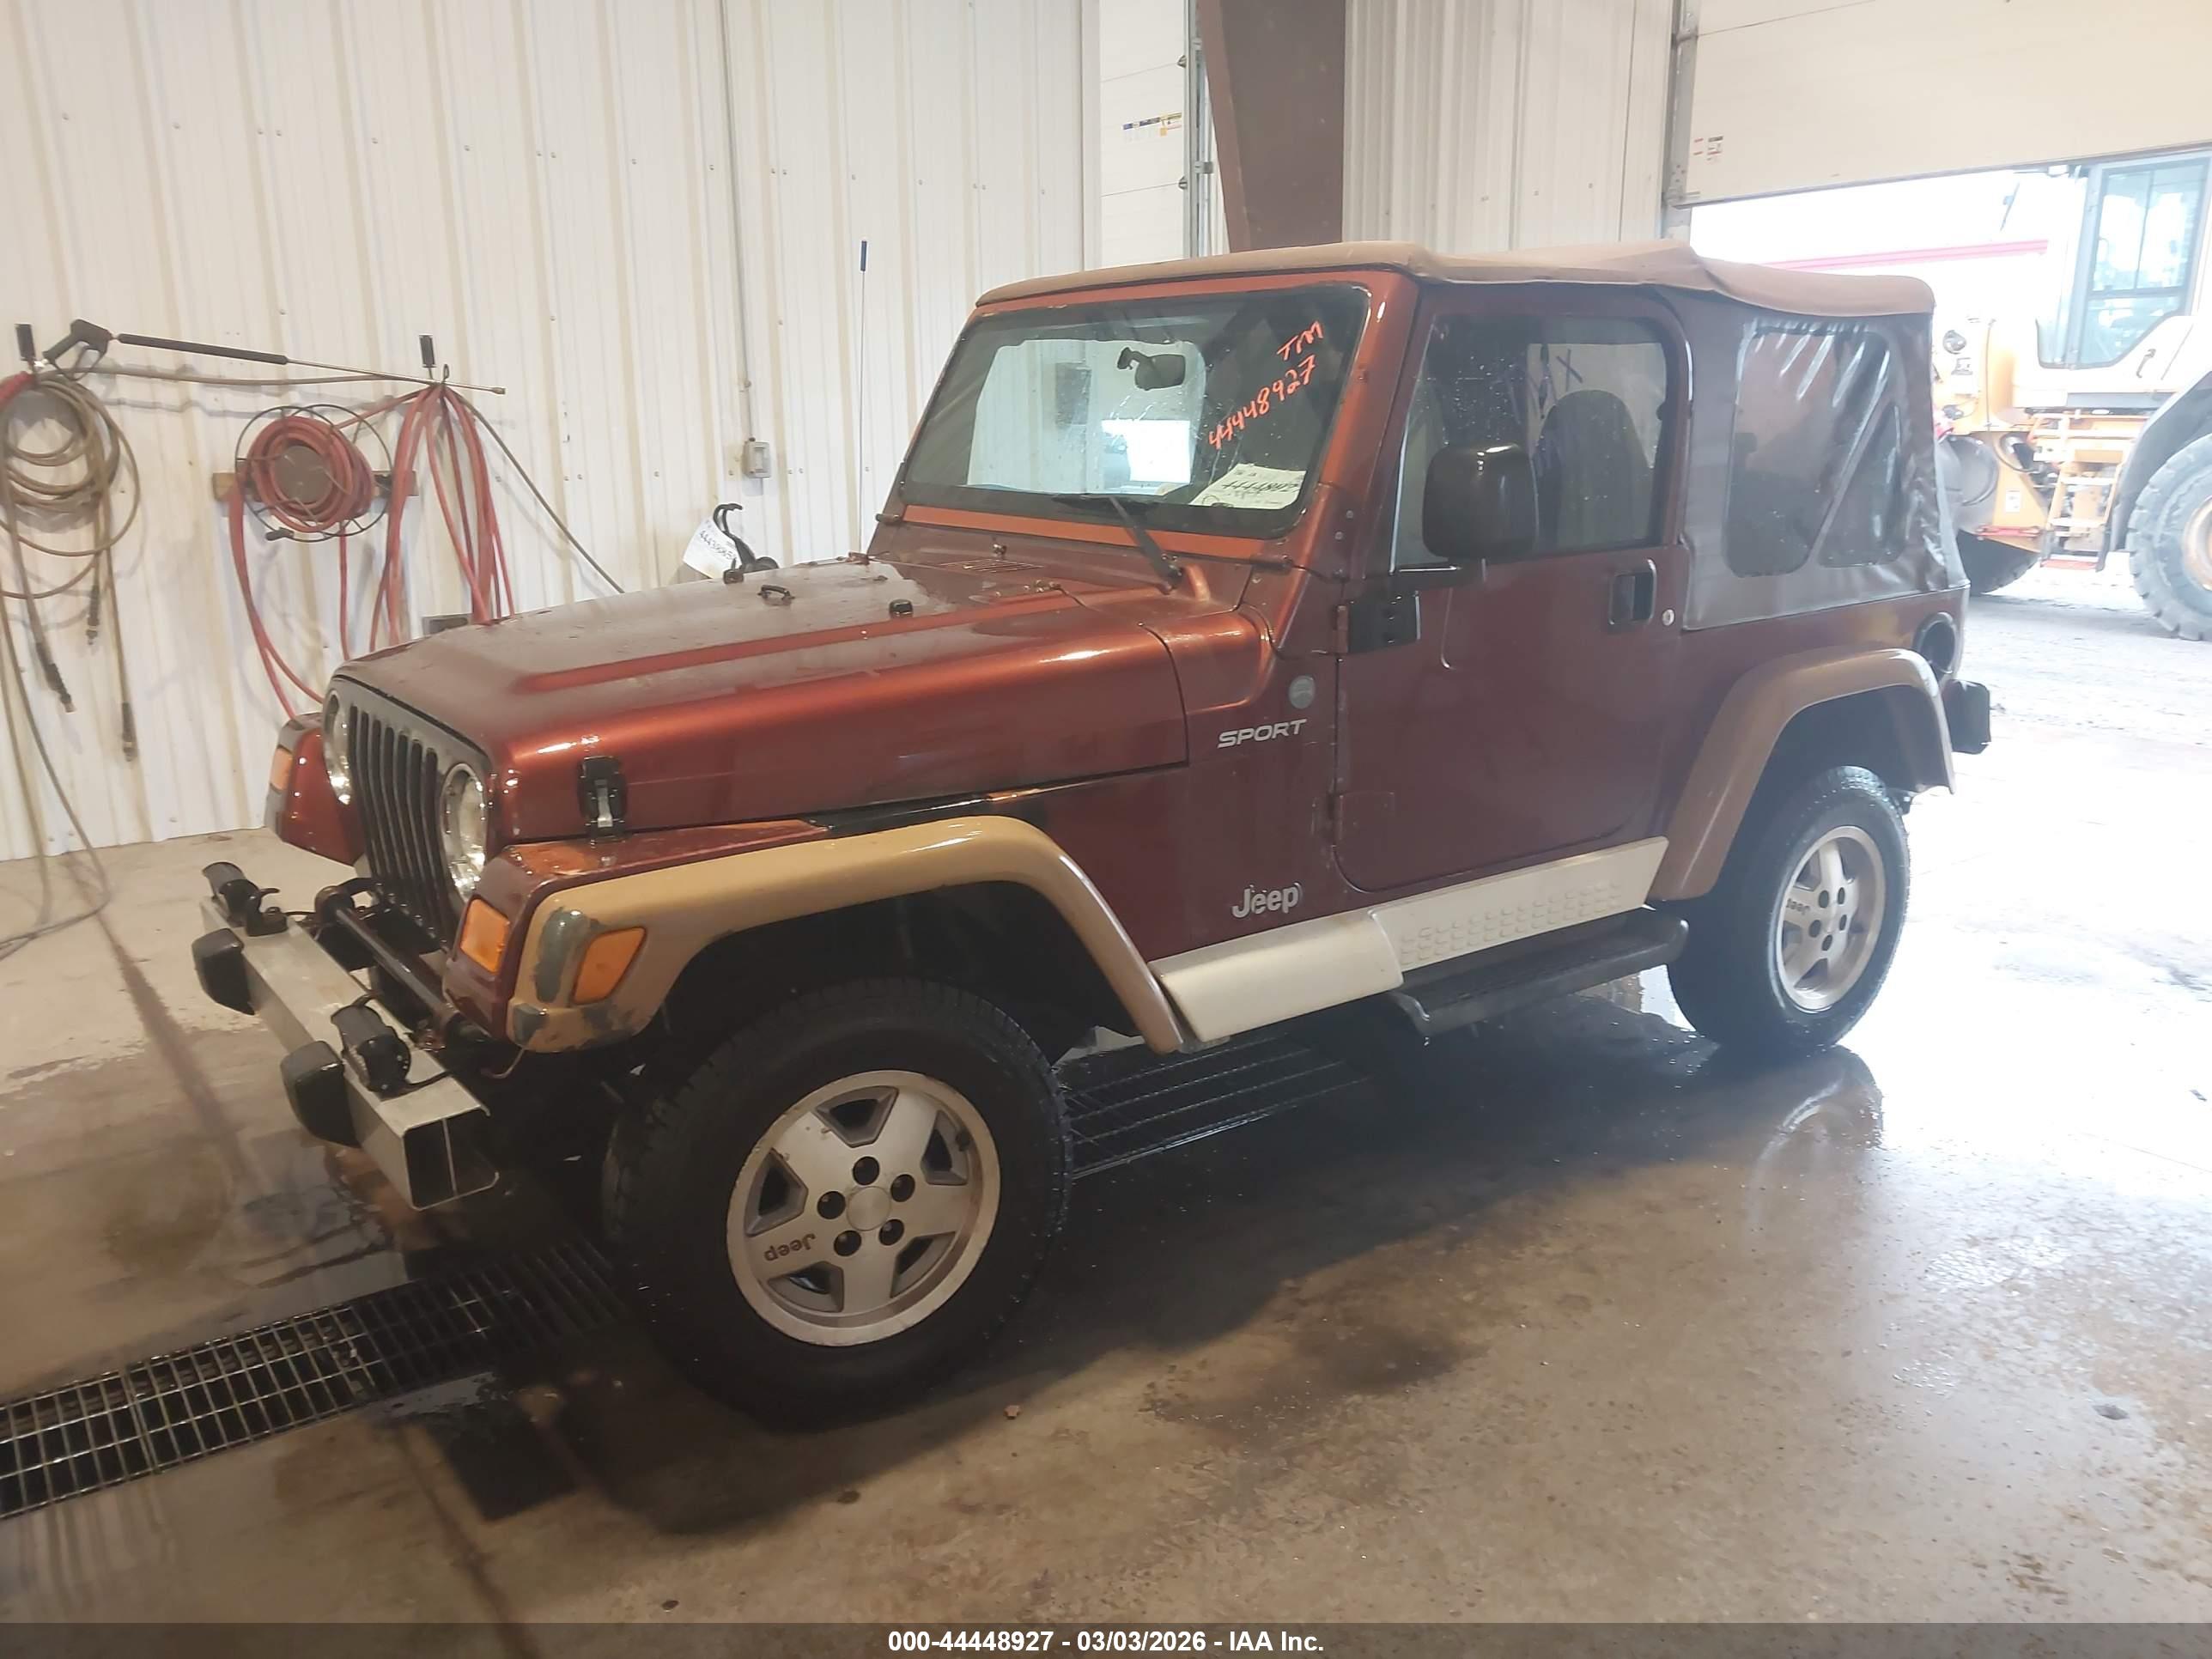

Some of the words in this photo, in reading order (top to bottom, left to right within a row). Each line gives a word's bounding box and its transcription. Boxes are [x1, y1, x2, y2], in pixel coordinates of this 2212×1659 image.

[1277, 321, 1323, 360] TM
[1209, 355, 1316, 449] 44448927
[1217, 719, 1307, 749] SPORT
[1232, 886, 1299, 918] Jeep
[764, 1233, 816, 1261] Jeep
